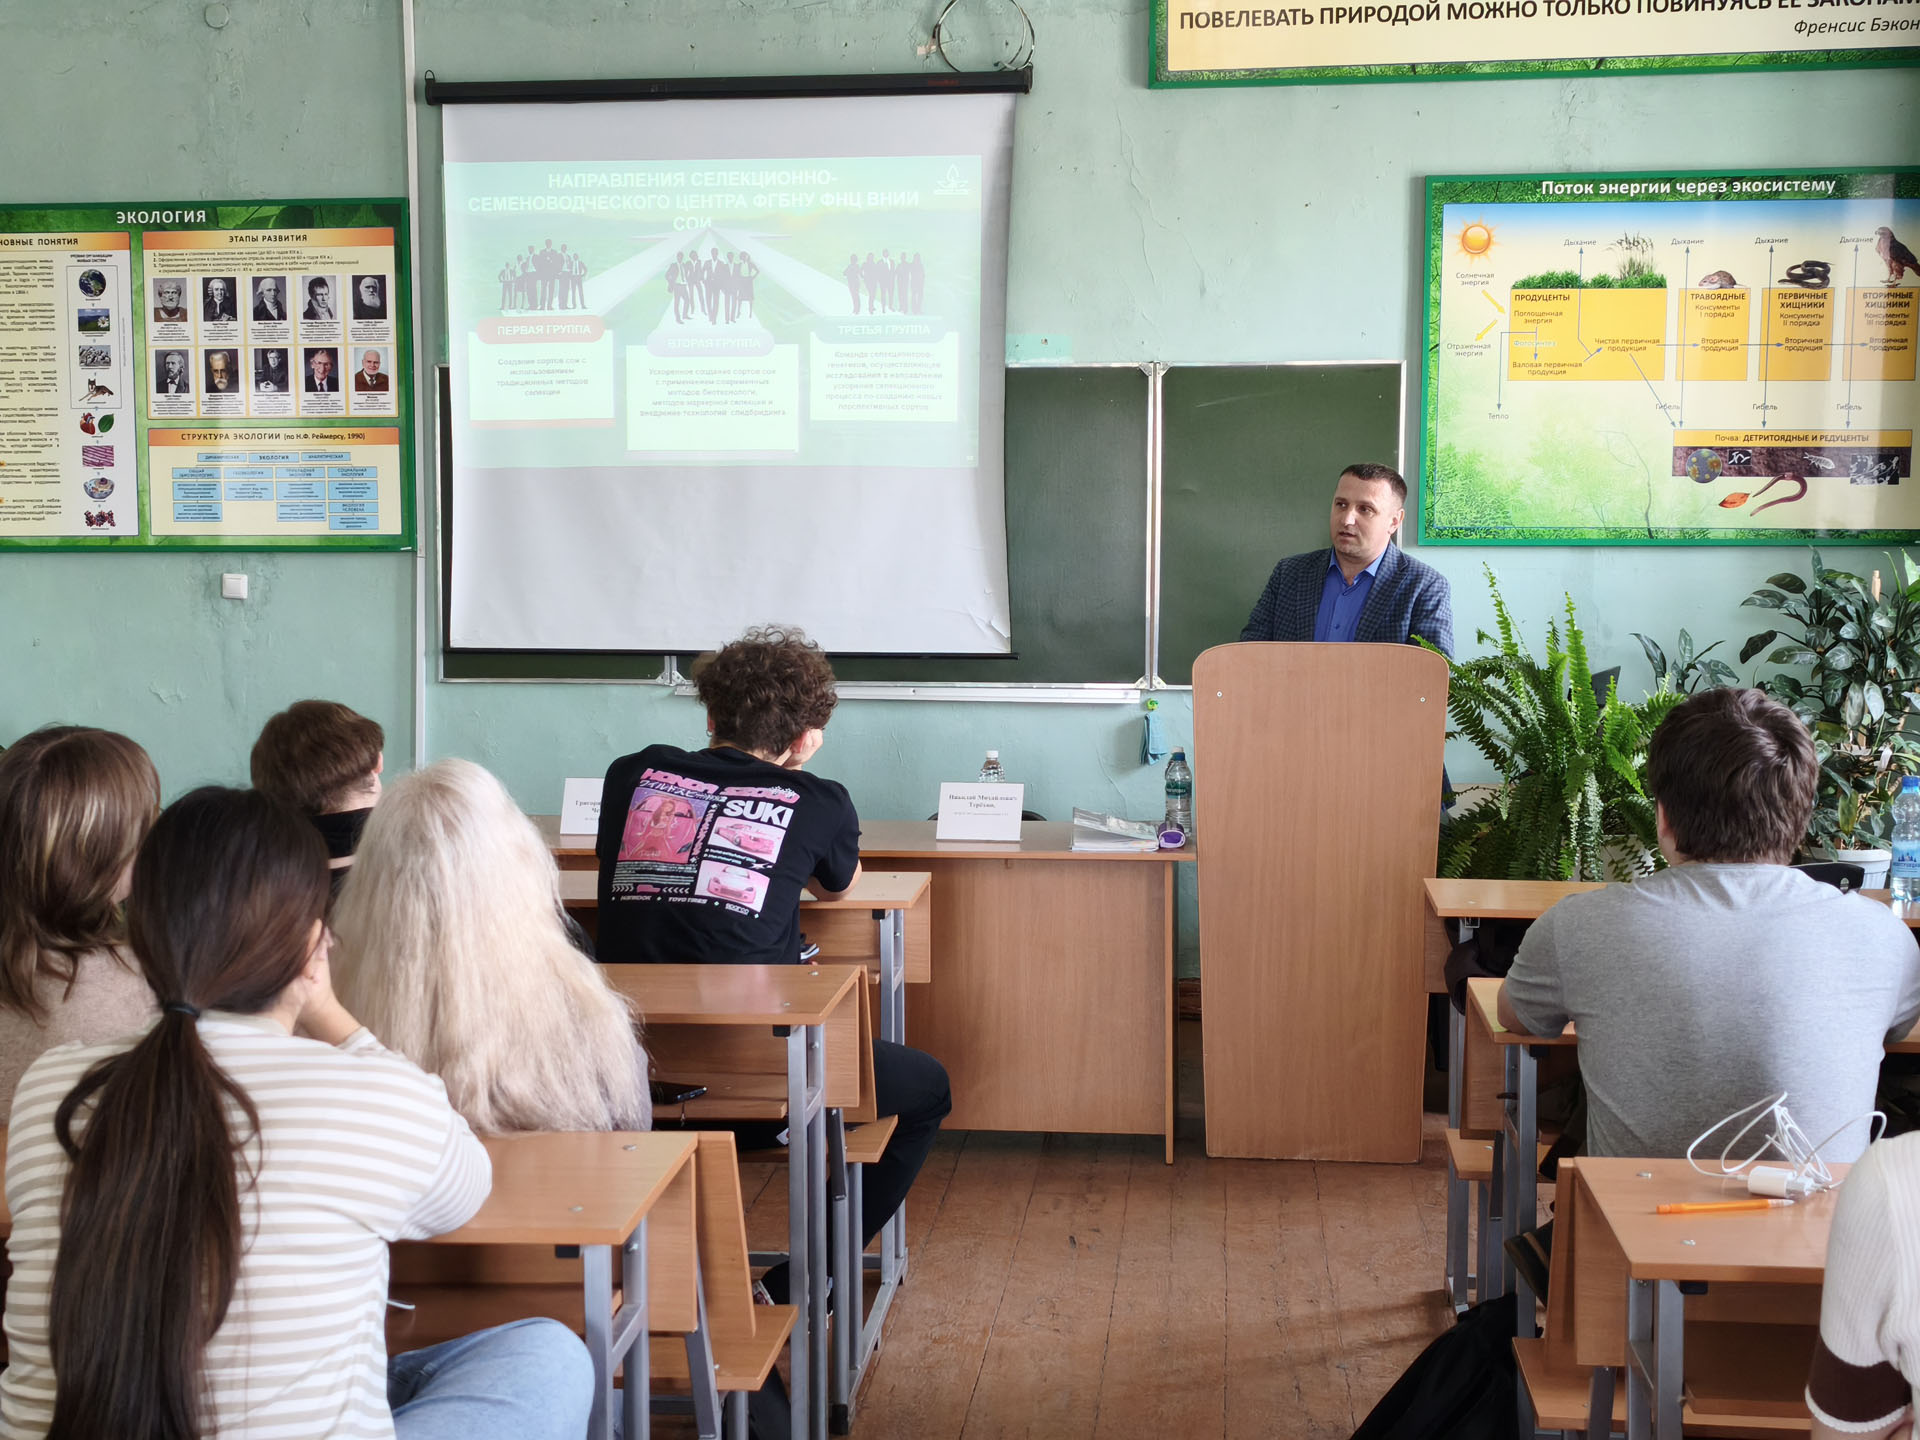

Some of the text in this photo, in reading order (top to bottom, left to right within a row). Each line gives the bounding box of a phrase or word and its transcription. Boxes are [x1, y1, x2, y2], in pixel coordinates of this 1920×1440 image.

[1179, 11, 1314, 30] ПОВЕЛЕВАТЬ
[1320, 0, 1441, 27] ПРИРОДОЙ
[1447, 0, 1538, 21] МОЖНО
[1543, 0, 1631, 17] ТОЛЬКО
[1794, 17, 1920, 37] Френсис Бэкон
[548, 169, 839, 189] НАПРАВЛЕНИЯ СЕЛЕКЦИОННО-
[1541, 179, 1836, 197] Поток энергии через экосистему
[468, 190, 920, 213] СЕМЕНОВОДЧЕСКОГО ЦЕНТРА ФГБНУ ФНЦ ВНИИ
[116, 209, 207, 225] ЭКОЛОГИЯ
[672, 216, 712, 232] СОИ
[37, 238, 79, 246] ПОНЯТИЯ
[228, 234, 308, 243] ЭТАПЫ РАЗВИТИЯ
[1563, 238, 1597, 247] Дыхание
[1671, 237, 1705, 246] Дыхание
[1755, 236, 1789, 245] Дыхание
[1839, 236, 1874, 245] Дыхание
[1455, 272, 1495, 280] Солнечная
[1460, 279, 1490, 287] энергия
[1514, 293, 1571, 302] ПРОДУЦЕНТЫ
[1690, 292, 1746, 301] ТРАВОЯДНЫЕ
[1777, 292, 1828, 300] ПЕРВИЧНЫЕ
[1862, 291, 1914, 299] ВТОРИЧНЫЕ
[1695, 304, 1741, 312] Консументы
[1780, 301, 1825, 309] ХИЩНИКИ
[1864, 300, 1910, 309] ХИЩНИКИ
[1513, 310, 1564, 318] Поглощенная
[1704, 311, 1735, 319] порядка
[1779, 312, 1825, 320] Консументы
[1864, 312, 1910, 320] Консументы
[1789, 319, 1821, 328] порядка
[497, 323, 593, 337] ПЕРВАЯ ГРУППА
[838, 325, 882, 337] ТРЕТЬЯ
[1594, 337, 1660, 346] Чистая первичная
[1701, 337, 1740, 345] Вторичная
[1784, 337, 1824, 345] Вторичная
[1607, 345, 1648, 353] продукция
[1868, 344, 1908, 352] продукция
[1512, 361, 1583, 370] Валовая первичная
[1527, 368, 1567, 376] продукция
[181, 432, 366, 441] СТРУКТУРА ЭКОЛОГИИ (по Н.Ф. Реймерсу, 1990)
[1742, 434, 1810, 443] ДЕТРИТОЯДНЫЕ
[1811, 434, 1818, 442] И
[1819, 434, 1869, 443] РЕДУЦЕНТЫ
[723, 799, 795, 829] SUKI
